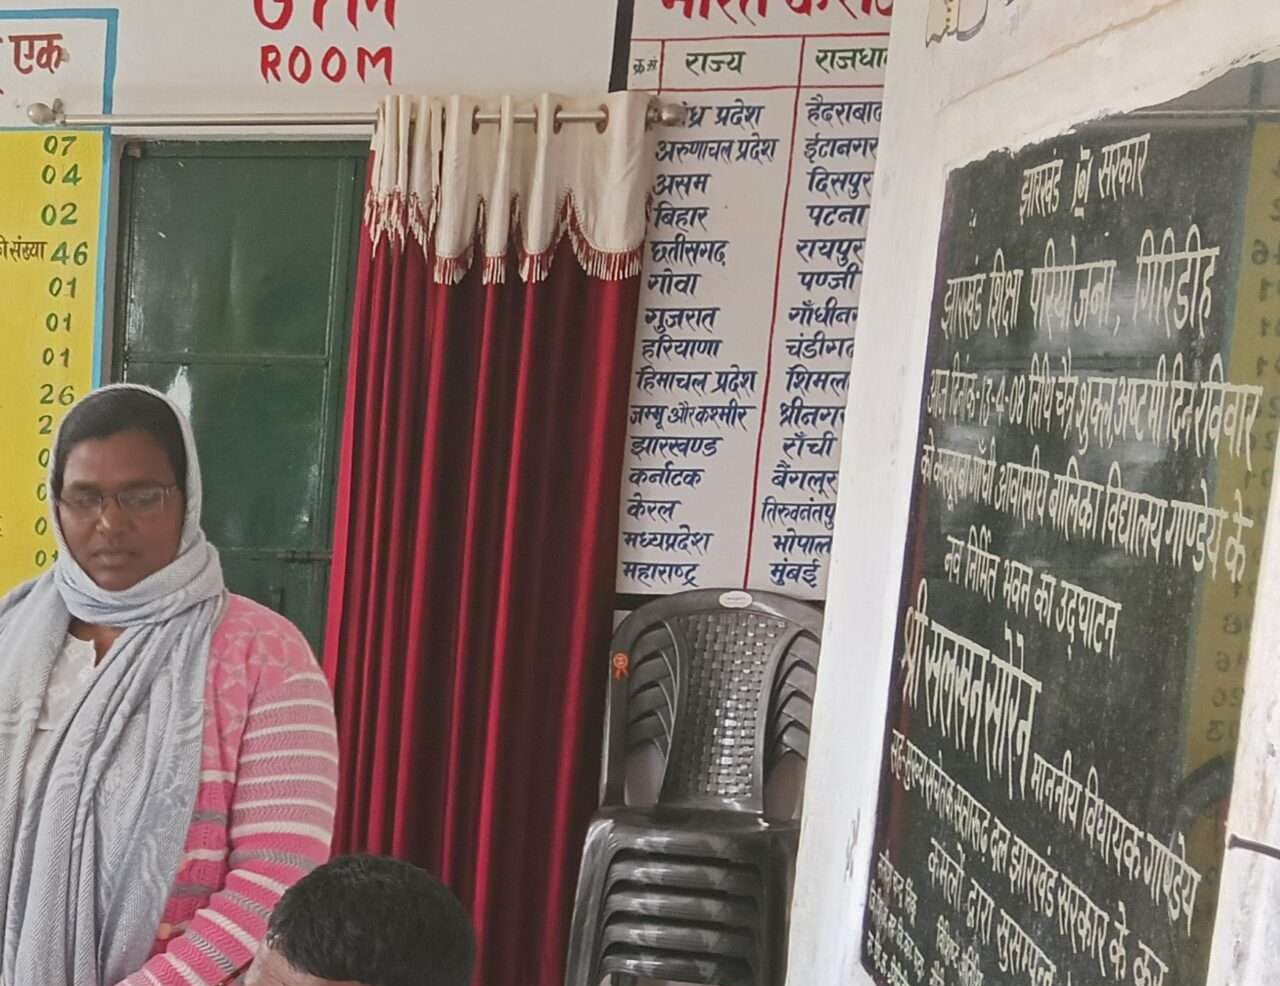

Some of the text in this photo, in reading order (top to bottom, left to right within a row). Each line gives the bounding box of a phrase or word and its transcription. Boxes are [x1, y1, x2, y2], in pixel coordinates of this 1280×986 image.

[9, 33, 63, 75] एक
[261, 45, 393, 86] ROOM
[686, 51, 746, 76] राज्य
[815, 48, 888, 74] राजधा
[715, 99, 765, 130] प्रदेश
[43, 135, 77, 157] 07
[656, 132, 780, 165] अरुणाचल प्रदेश
[41, 164, 82, 186] 04
[653, 173, 712, 200] असम
[806, 166, 873, 200] दिसपुर
[1020, 133, 1150, 224] झारखंड सरकार
[41, 202, 78, 226] 02
[653, 200, 711, 233] बिहार
[806, 204, 870, 227] पटना
[10, 236, 48, 264] संख्या
[50, 241, 88, 266] 46
[796, 238, 865, 268] रायपुर
[48, 276, 77, 298] 01
[647, 268, 702, 296] गोवा
[941, 256, 986, 339] झारखंड
[987, 248, 1023, 337] शिक्षा
[1132, 224, 1219, 338] गिरिडीह
[45, 312, 71, 333] 01
[644, 307, 720, 334] गुजरात
[42, 347, 70, 369] 01
[641, 334, 723, 364] हरियाणा
[39, 384, 75, 405] 26
[635, 364, 758, 400] हिमाचल प्रदेश
[630, 398, 757, 431] जम्मू और कश्मीर
[1195, 354, 1263, 471] रविवार
[631, 436, 723, 461] झारखण्ड
[782, 430, 838, 460] राँची
[629, 460, 705, 489] कर्नाटक
[627, 492, 682, 523] केरल
[921, 428, 935, 482] को
[995, 445, 1049, 528] आवासीय
[1049, 456, 1104, 539] बालिका
[1102, 461, 1168, 561] विद्यालय
[1166, 479, 1228, 578] गाण्डेय
[1225, 489, 1253, 582] के
[622, 524, 715, 556] मध्यप्रदेश
[772, 528, 832, 554] भोपाल
[622, 561, 700, 588] महाराष्ट्र
[769, 558, 821, 589] मुंबई
[945, 536, 964, 582] नव
[1004, 560, 1033, 616] भवन
[1034, 574, 1056, 626] का
[902, 578, 928, 706] श्री
[926, 621, 989, 758] सलखन
[985, 622, 1042, 799] सोरेन
[1031, 750, 1082, 827] माननीय
[1081, 766, 1144, 880] विधायक
[967, 879, 994, 944] द्वारा
[991, 818, 1010, 870] दल
[1009, 835, 1058, 917] झारखंड
[1058, 874, 1112, 976] सरकार
[1109, 901, 1129, 979] के
